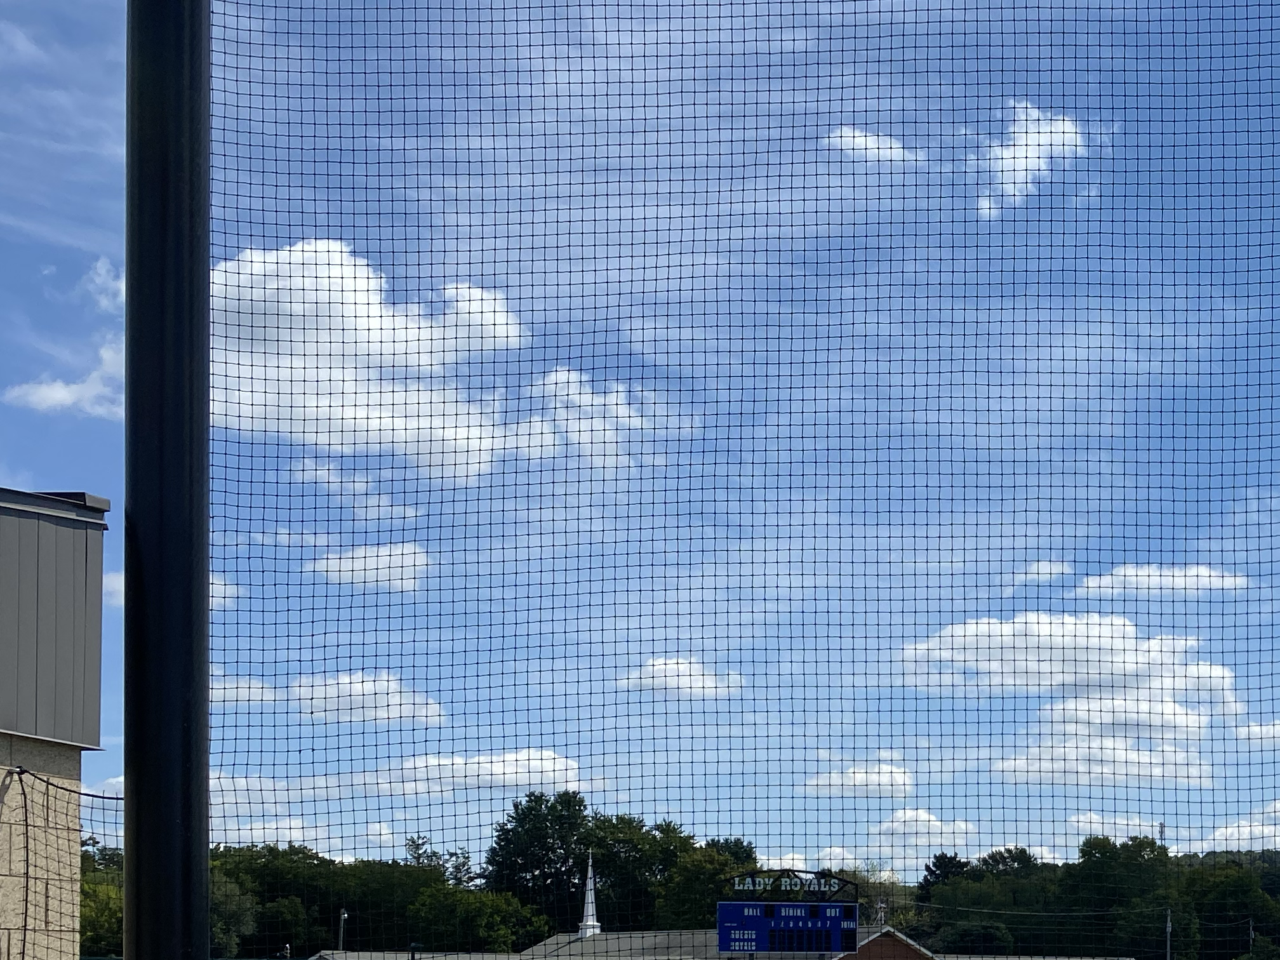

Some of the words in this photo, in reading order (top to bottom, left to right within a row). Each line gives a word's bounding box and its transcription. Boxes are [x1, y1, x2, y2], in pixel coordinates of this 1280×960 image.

[734, 877, 774, 890] LADY
[780, 878, 839, 891] ROYALS
[744, 907, 760, 916] BALL
[781, 907, 805, 917] STRIKE
[826, 908, 840, 917] OUT
[841, 921, 856, 929] TOTAL
[730, 930, 756, 939] GUESTS
[730, 941, 756, 950] ROYALS
